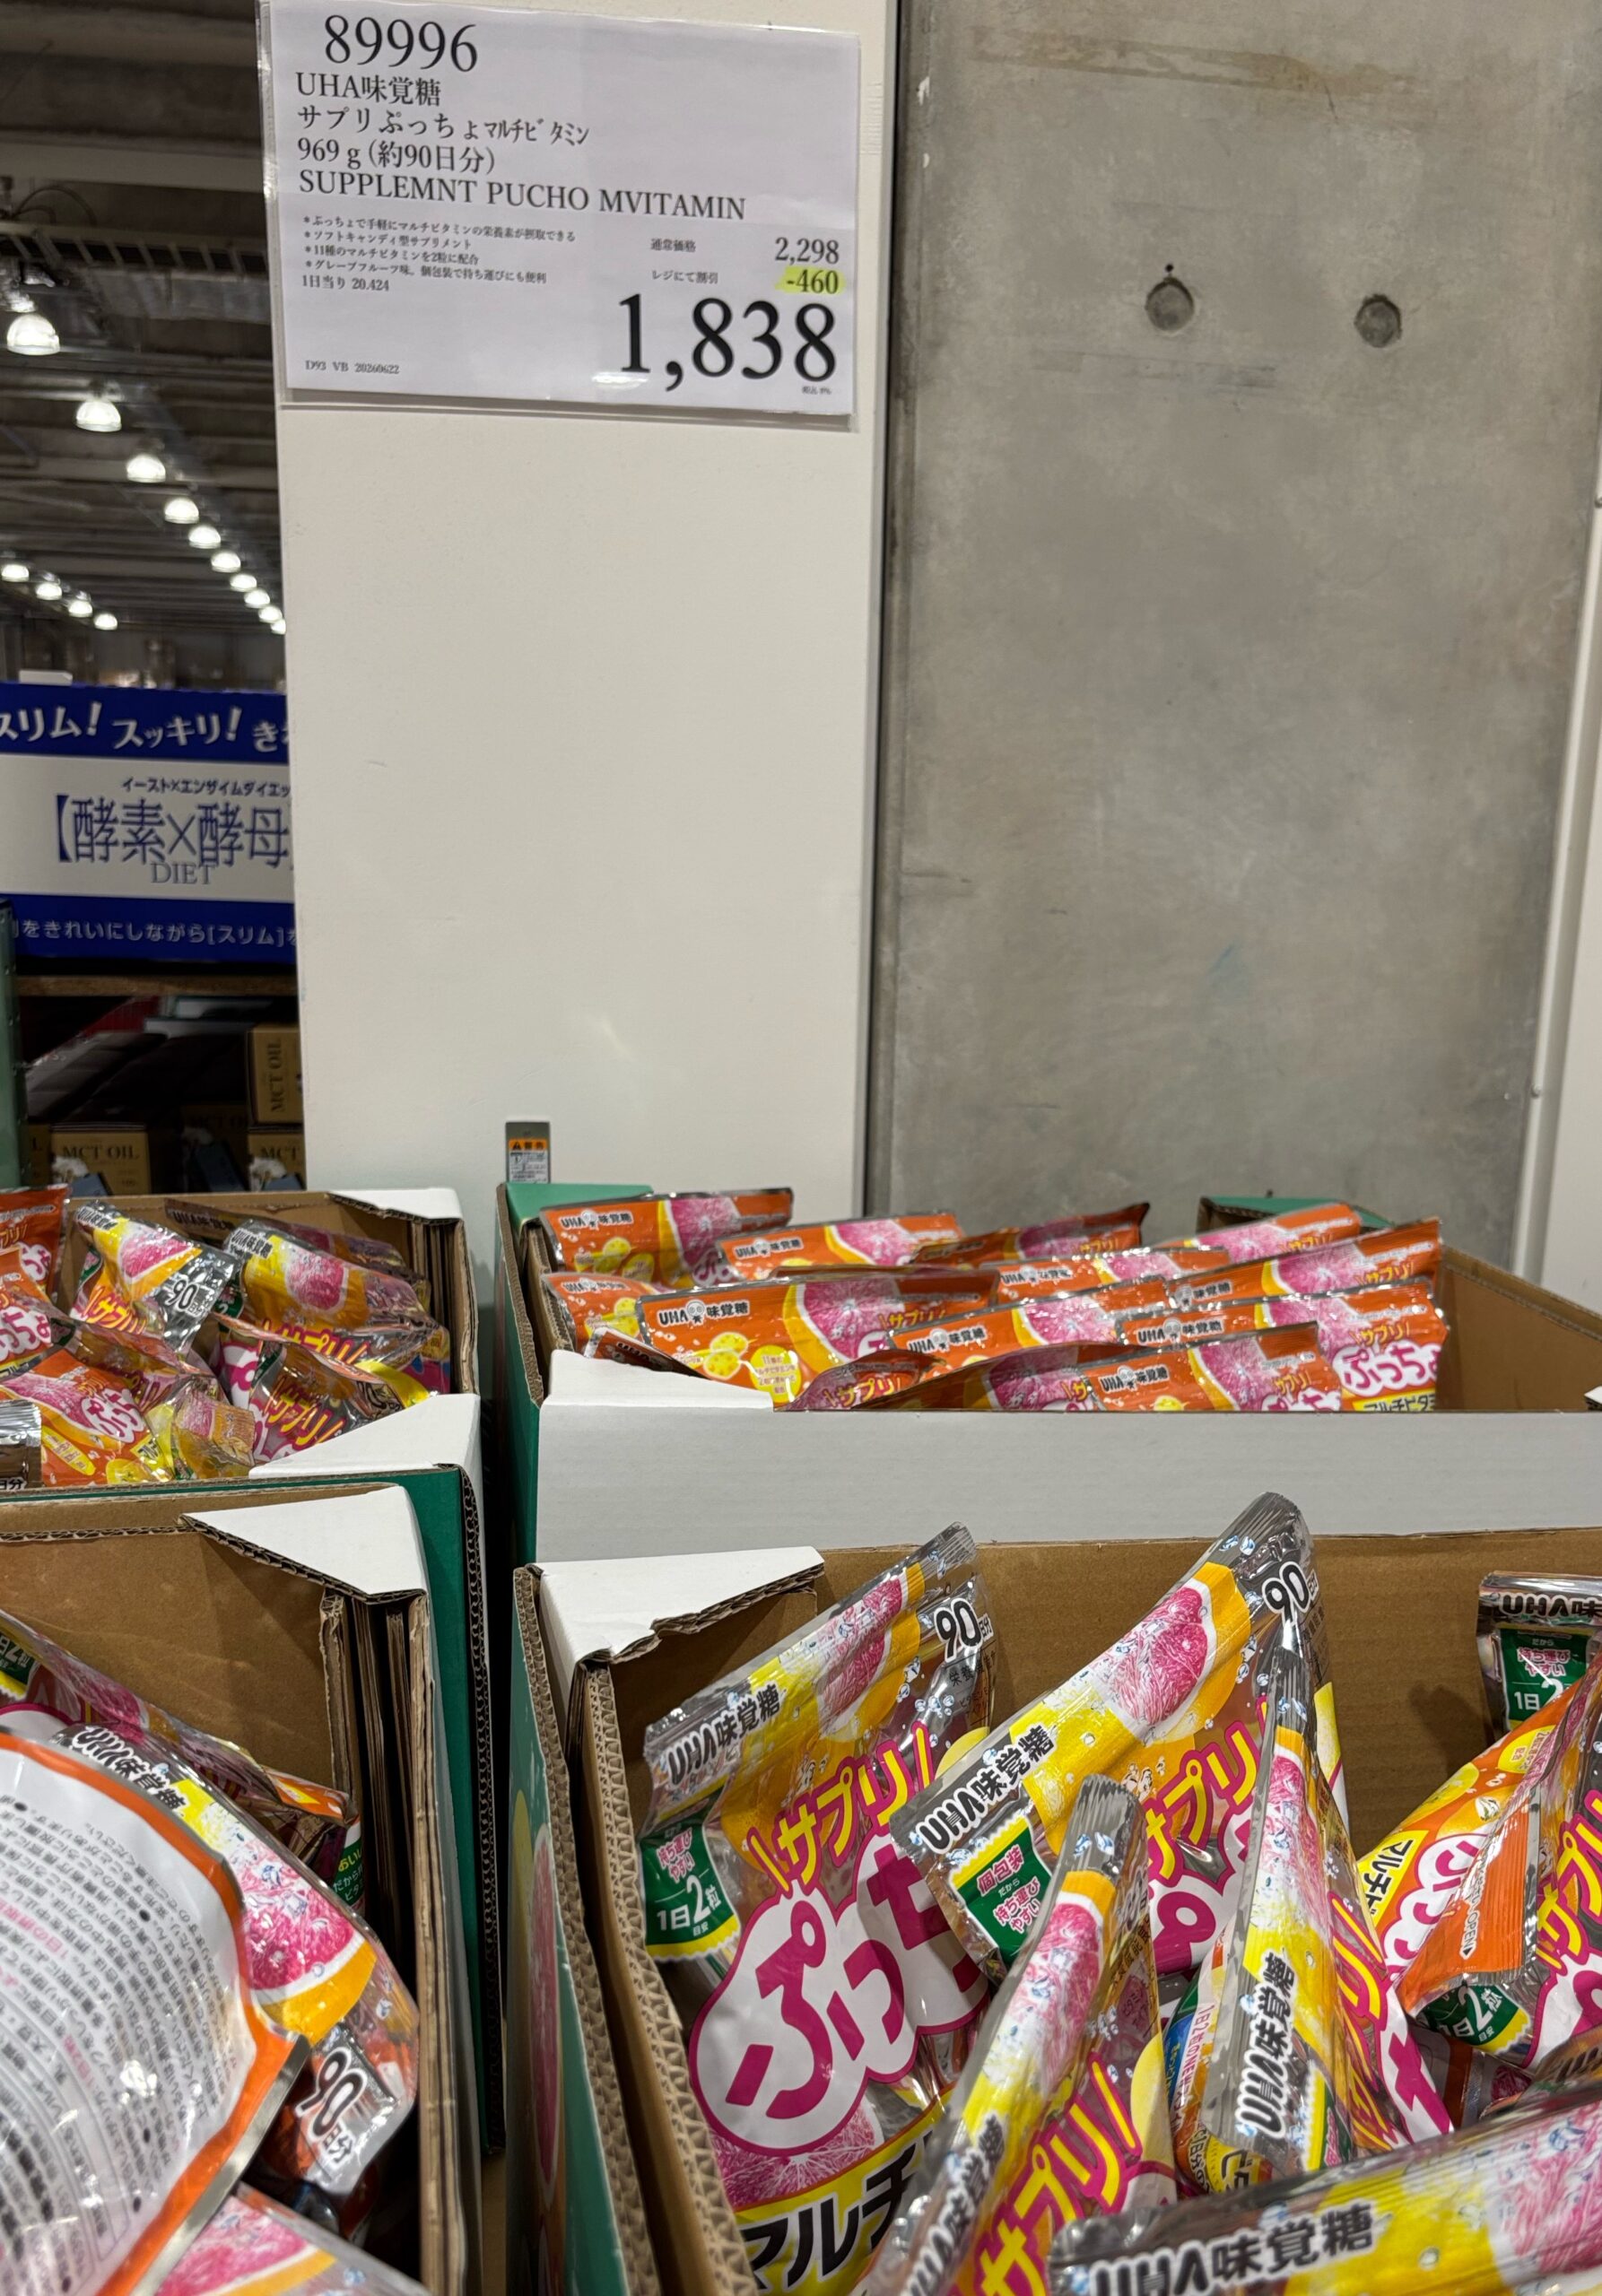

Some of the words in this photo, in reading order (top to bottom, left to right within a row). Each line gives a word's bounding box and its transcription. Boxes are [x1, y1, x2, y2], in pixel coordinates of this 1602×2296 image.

[324, 13, 477, 72] 89996
[296, 71, 441, 107] UHA味覚糖
[299, 170, 478, 204] SUPPLEMNT
[487, 182, 590, 213] PUCHO
[598, 189, 747, 221] MVITAMIN
[650, 238, 697, 253] 通常価格
[774, 237, 840, 265] 2,298
[652, 270, 718, 285] レジにて割引
[786, 270, 840, 295] -460
[619, 293, 837, 392] 1,838
[151, 861, 216, 885] DIET
[62, 1145, 104, 1161] MCT
[107, 1144, 141, 1160] OIL
[259, 1146, 301, 1161] MCT
[659, 1301, 750, 1326] UHA味覚糖
[666, 1683, 783, 1786] UHA味覚糖
[919, 1726, 1057, 1852] UHA味覚糖
[775, 1747, 908, 1887] サプリ
[977, 1844, 1024, 1897] 個包装
[657, 1874, 722, 1931] 1日2粒
[993, 1878, 1041, 1926] 持ち運び
[1009, 1899, 1041, 1934] やすい
[1462, 1911, 1479, 1947] OPEN
[1239, 1952, 1296, 2134] UHA味覚糖
[1093, 2203, 1374, 2296] UHA味覚糖
